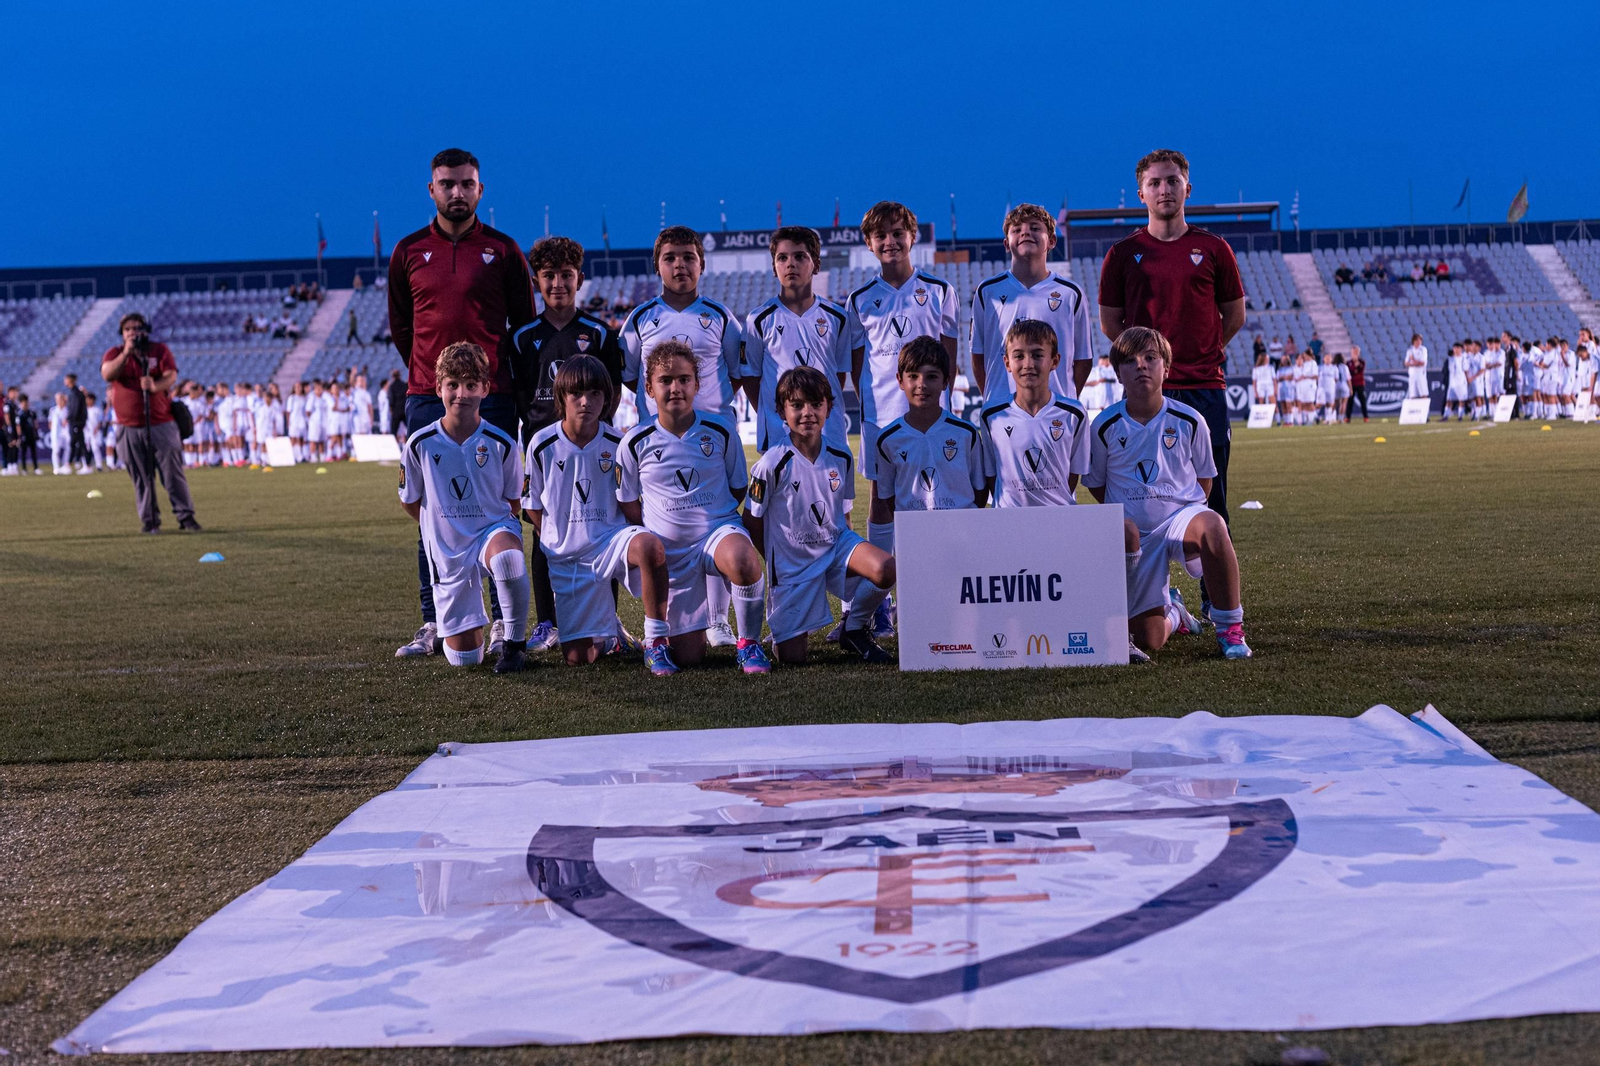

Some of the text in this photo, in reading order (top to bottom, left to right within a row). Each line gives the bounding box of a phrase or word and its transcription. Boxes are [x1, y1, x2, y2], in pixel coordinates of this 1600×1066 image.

[722, 231, 754, 248] JAÉN
[828, 228, 860, 245] JAÉN
[660, 492, 717, 508] VICTORIA PARK
[960, 569, 1063, 604] ALEVÍN C
[1062, 647, 1095, 655] LEVASA
[835, 940, 979, 958] 1922
